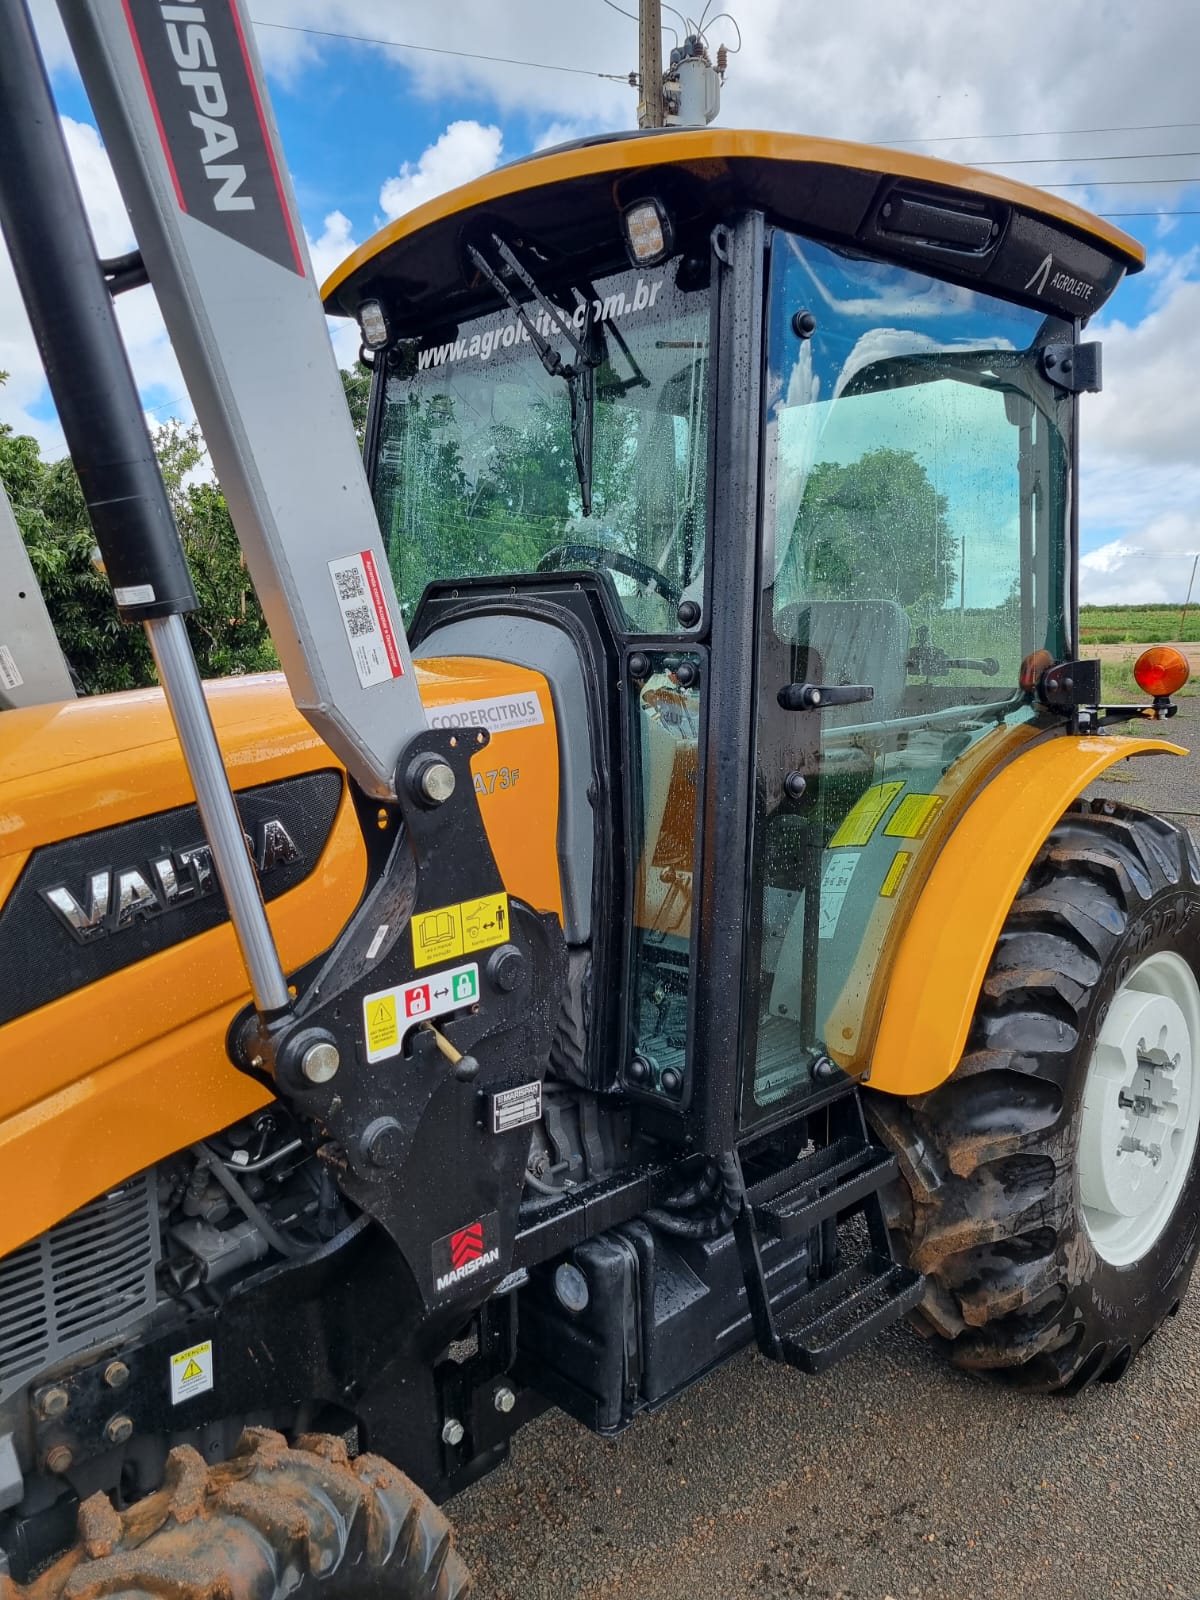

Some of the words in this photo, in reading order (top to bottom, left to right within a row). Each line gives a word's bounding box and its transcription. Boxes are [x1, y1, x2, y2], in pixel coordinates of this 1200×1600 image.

[159, 0, 255, 211] ISPAN
[1050, 271, 1093, 300] AGROLEITE
[431, 700, 536, 729] COOPERCITRUS
[42, 816, 301, 939] VALTA
[437, 1247, 499, 1291] MARISPAN
